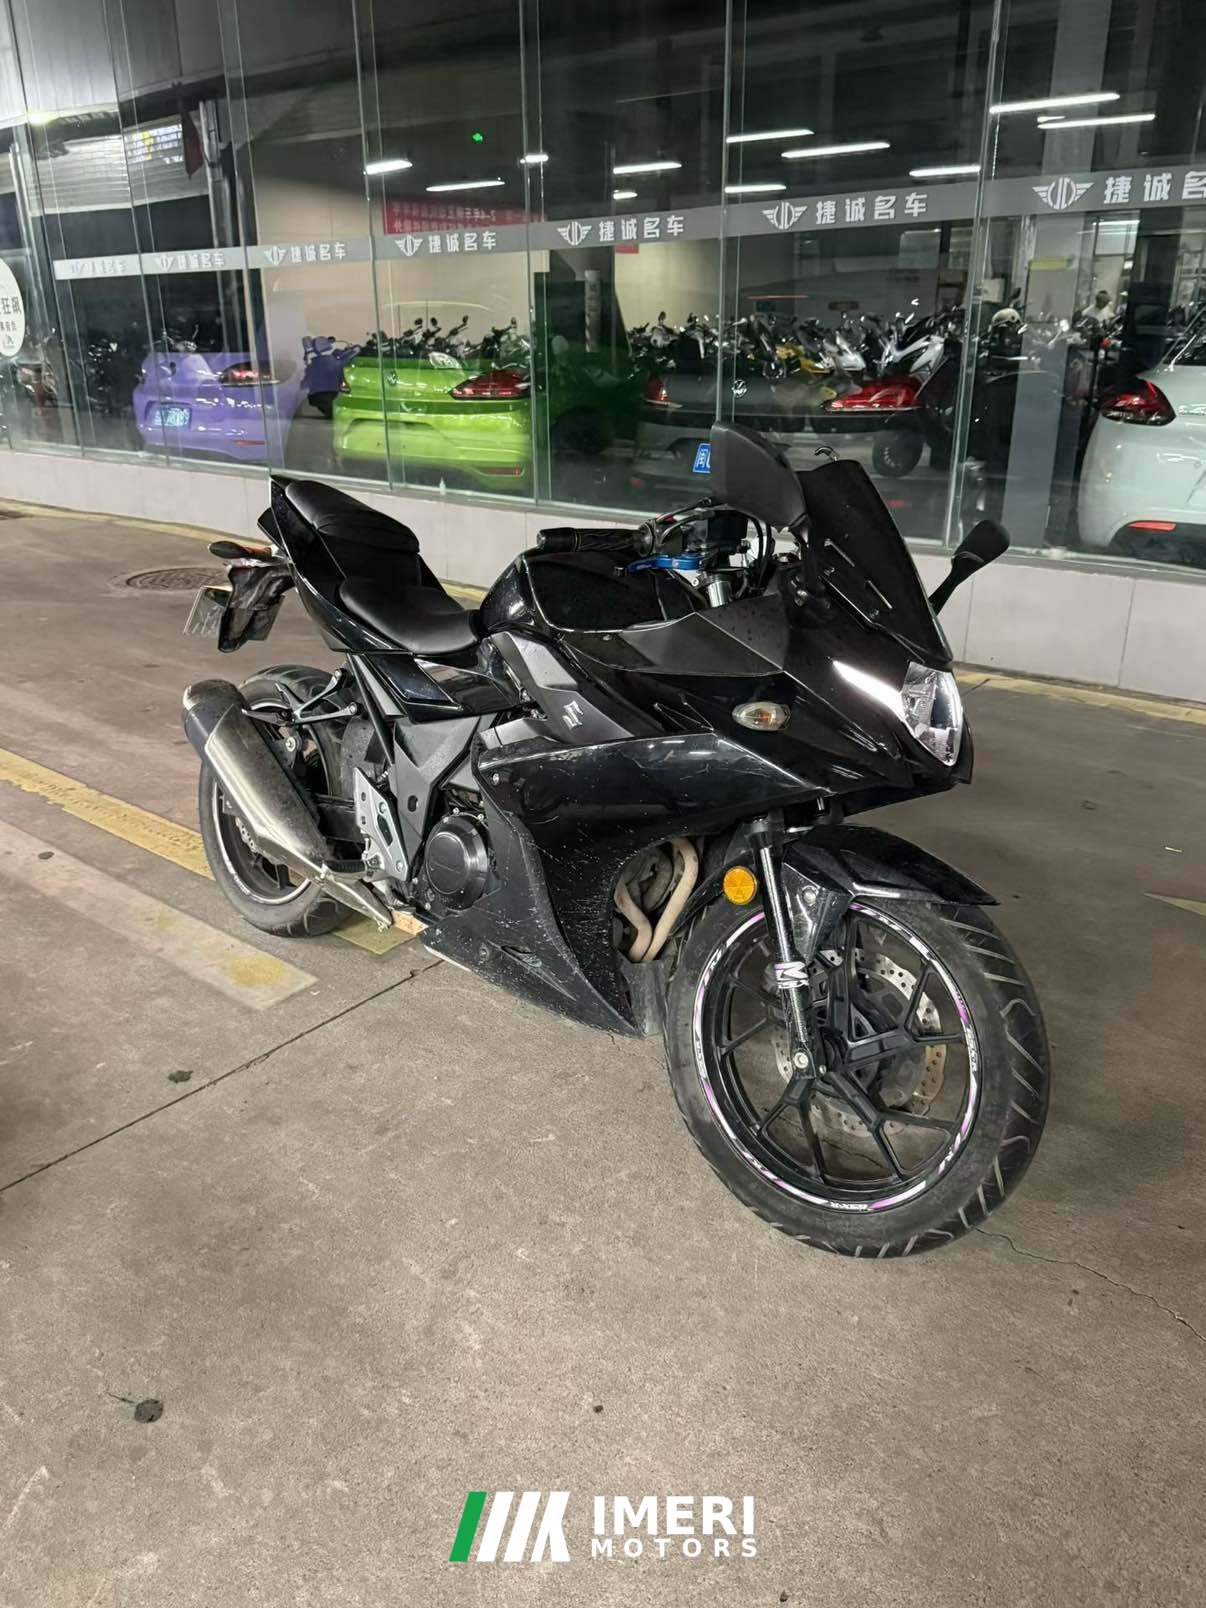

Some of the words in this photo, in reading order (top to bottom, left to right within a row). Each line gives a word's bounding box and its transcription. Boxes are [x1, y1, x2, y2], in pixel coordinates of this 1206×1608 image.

[815, 191, 928, 225] 捷诚名车
[427, 230, 497, 254] 捷诚名车
[598, 214, 685, 242] 捷诚名车
